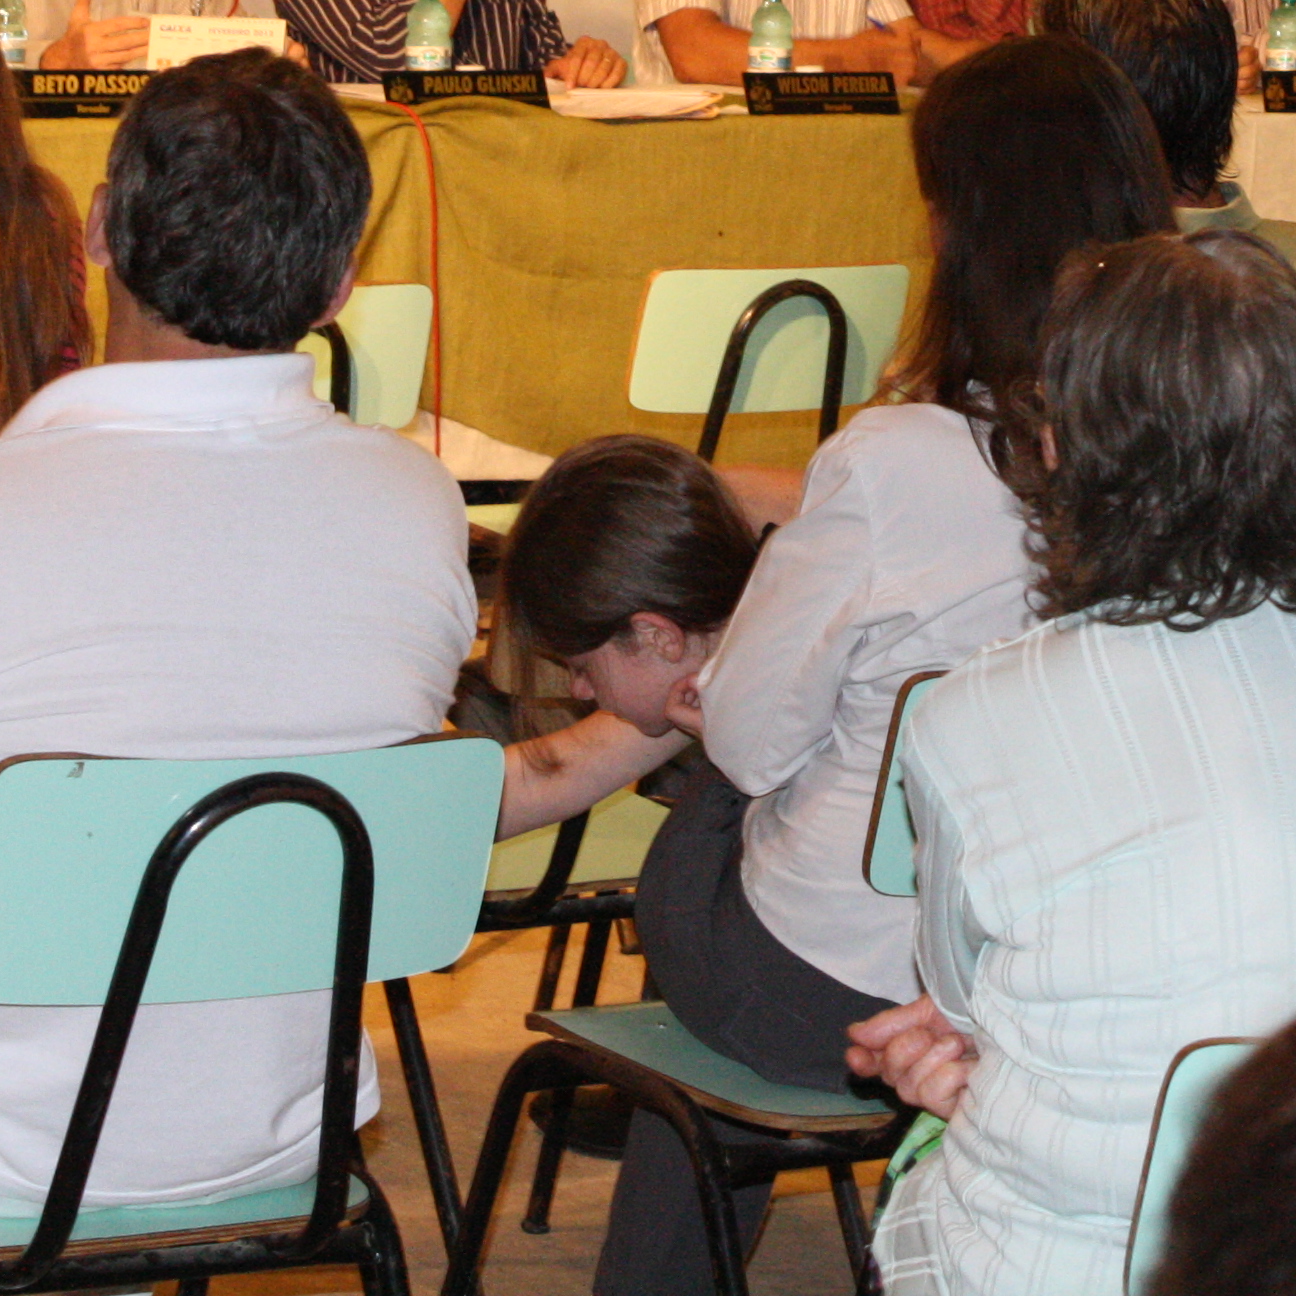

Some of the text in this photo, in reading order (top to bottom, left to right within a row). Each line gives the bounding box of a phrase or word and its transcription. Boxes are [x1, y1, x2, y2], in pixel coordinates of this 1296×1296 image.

[32, 74, 79, 94] BETO
[423, 74, 538, 94] PAULO GLINSKI
[777, 76, 889, 94] WILSON PEREIRA
